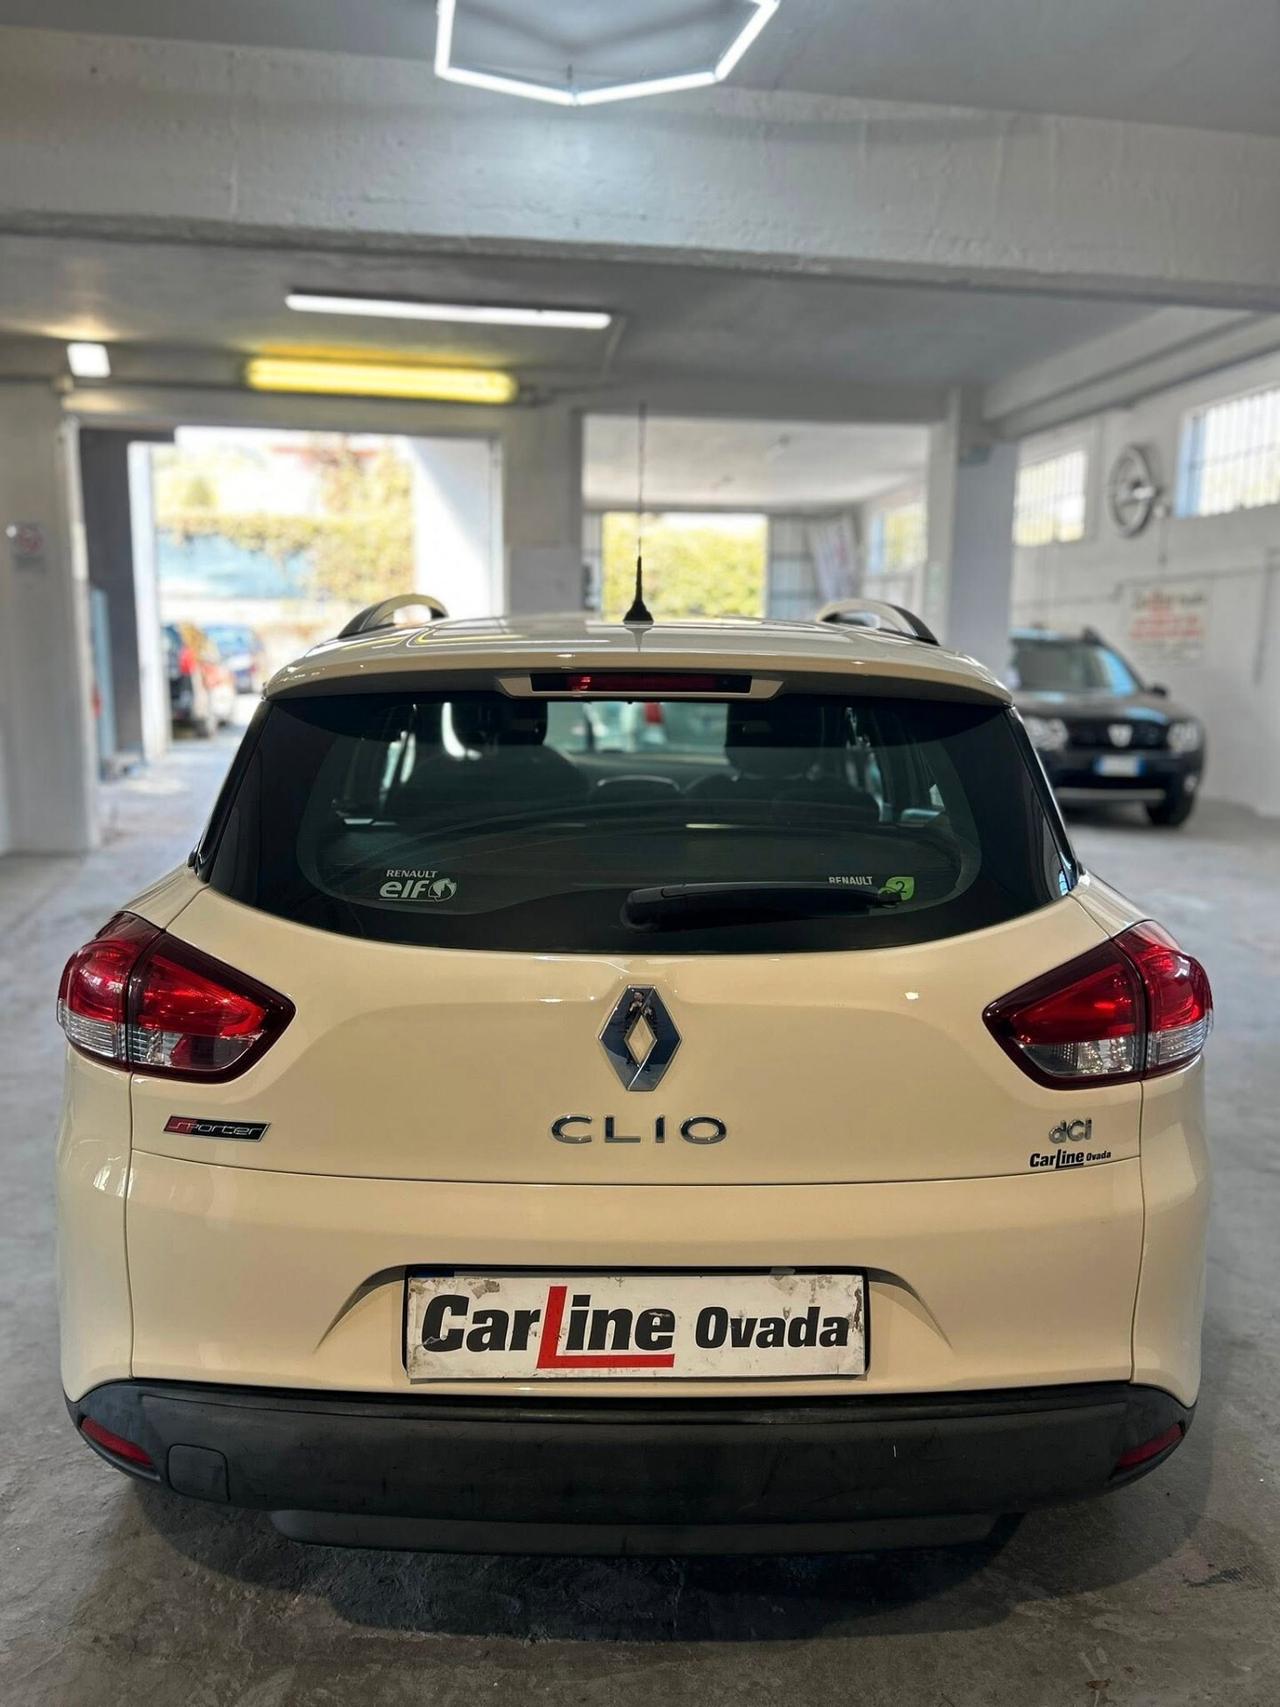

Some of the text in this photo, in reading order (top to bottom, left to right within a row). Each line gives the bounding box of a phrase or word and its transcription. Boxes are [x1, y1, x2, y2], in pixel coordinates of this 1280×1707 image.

[386, 869, 438, 878] RENAULT
[829, 876, 873, 886] RENAULT
[379, 880, 430, 899] elf
[551, 1115, 727, 1144] CLIO
[1029, 1149, 1112, 1169] CarLine Ovada
[421, 1285, 849, 1369] CarLine Ovada
